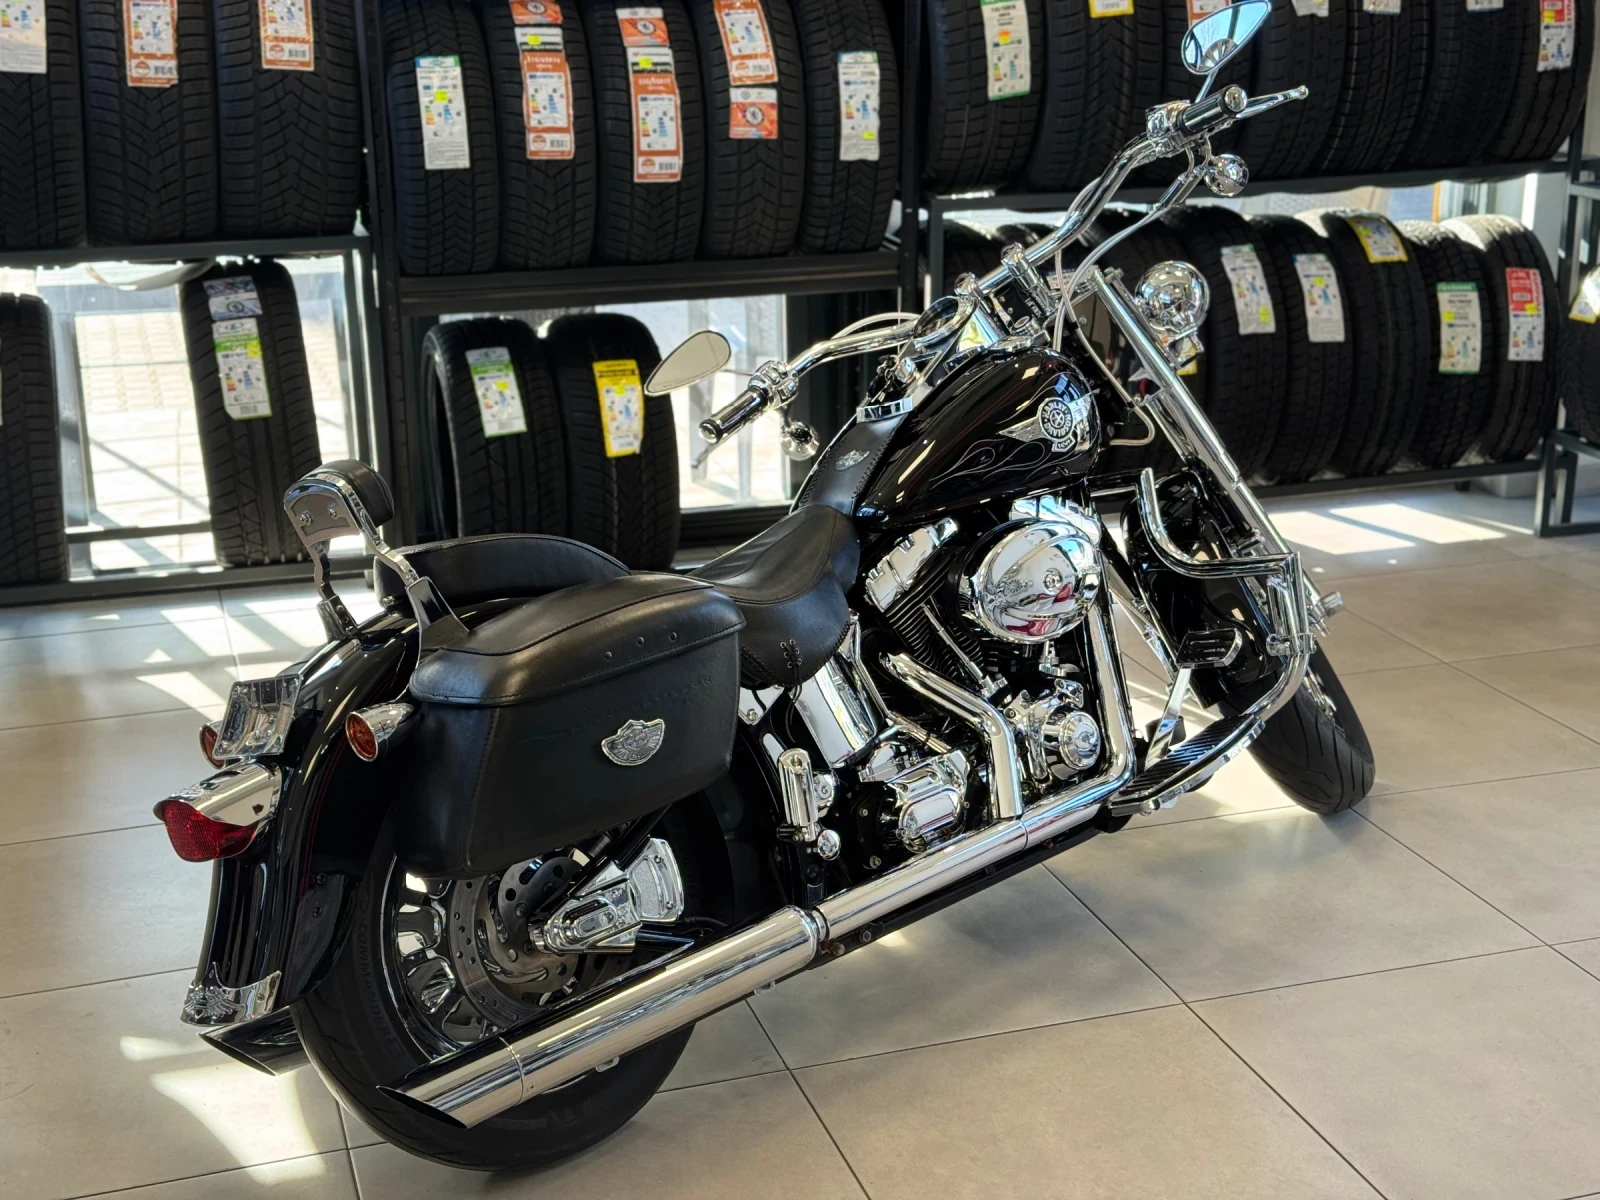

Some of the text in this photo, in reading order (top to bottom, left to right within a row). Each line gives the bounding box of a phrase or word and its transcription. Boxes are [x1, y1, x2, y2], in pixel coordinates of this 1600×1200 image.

[1042, 401, 1067, 419] HARLEY
[1043, 414, 1072, 437] DAVIDSON
[358, 922, 391, 1037] COMMANDER
